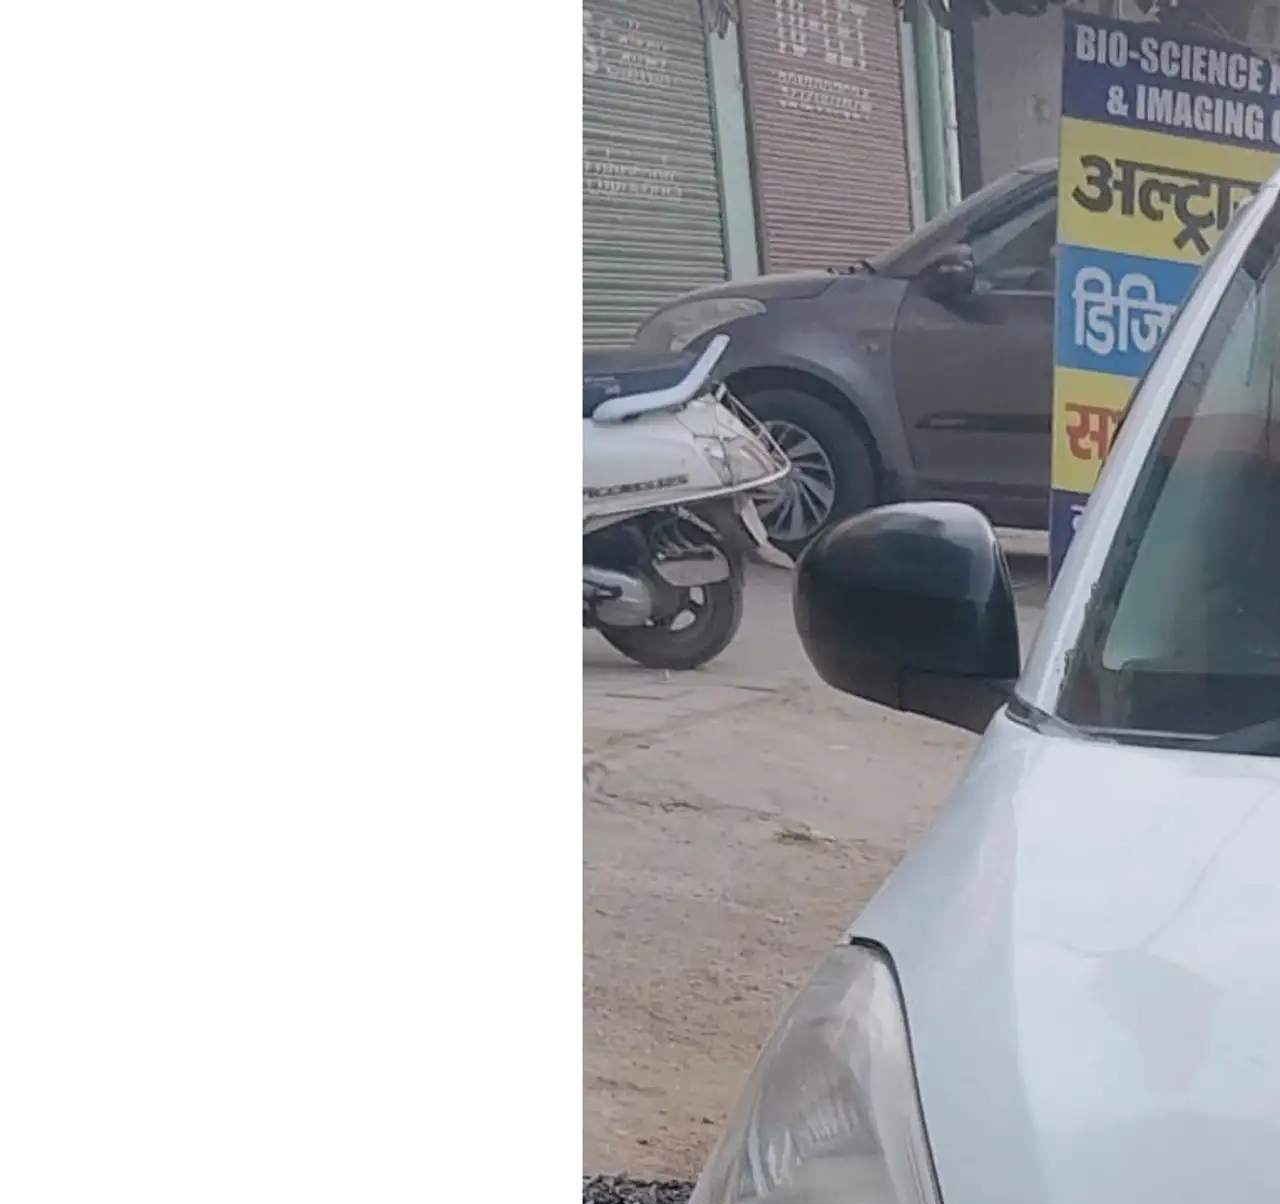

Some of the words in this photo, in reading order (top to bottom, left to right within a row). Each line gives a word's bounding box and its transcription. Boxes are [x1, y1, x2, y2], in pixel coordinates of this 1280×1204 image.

[1075, 24, 1264, 93] BIO-SCIENCE
[1106, 85, 1129, 118] &
[1136, 84, 1264, 142] IMAGING
